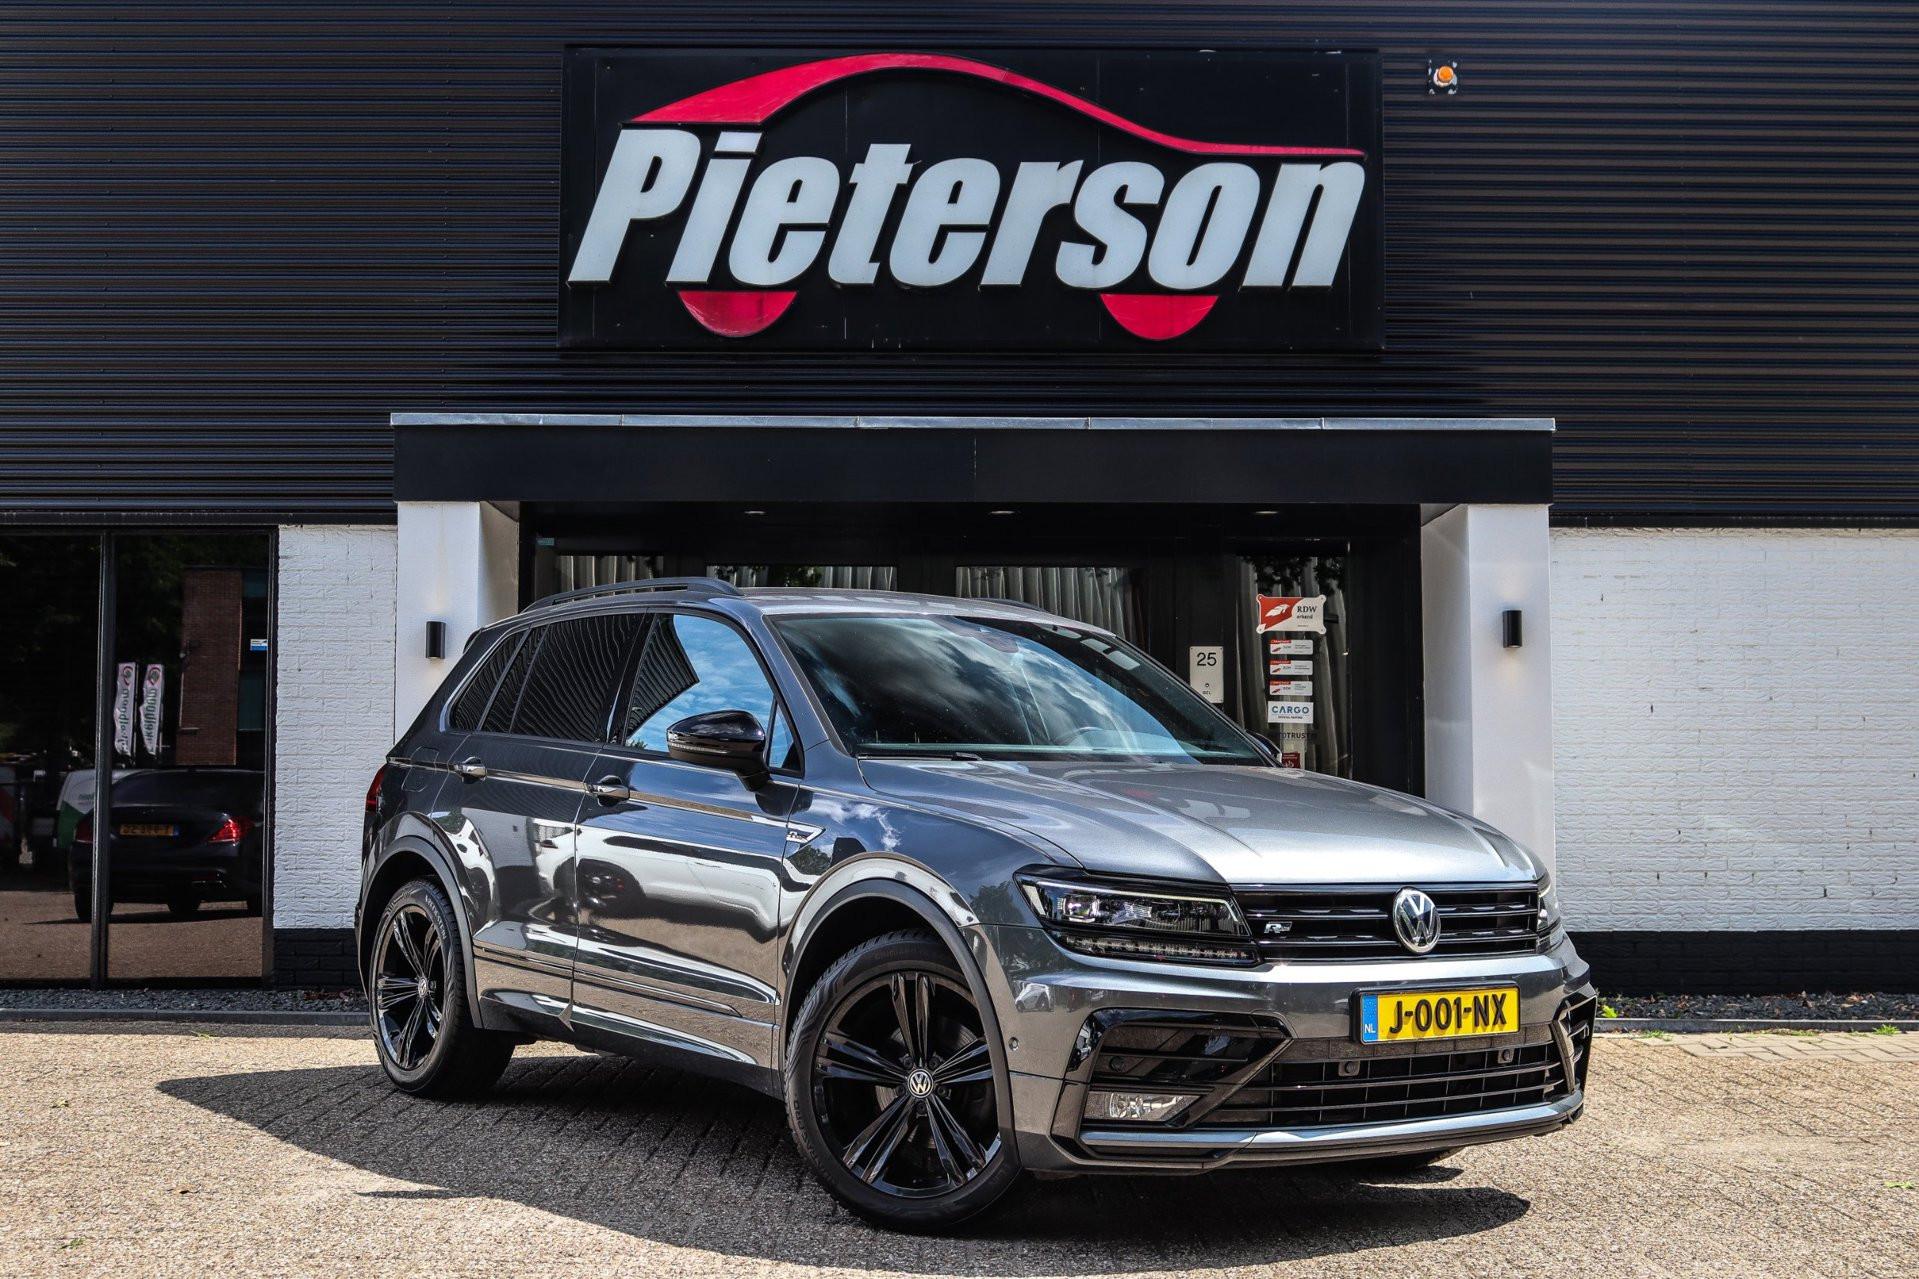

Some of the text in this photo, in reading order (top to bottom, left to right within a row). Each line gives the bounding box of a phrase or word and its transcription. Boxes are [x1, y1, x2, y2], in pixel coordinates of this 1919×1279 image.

[567, 129, 1366, 291] Pieterson
[1197, 652, 1217, 666] 25
[1271, 705, 1310, 714] CARGO
[1390, 993, 1508, 1034] J-001-NX
[1364, 1024, 1376, 1034] NL
